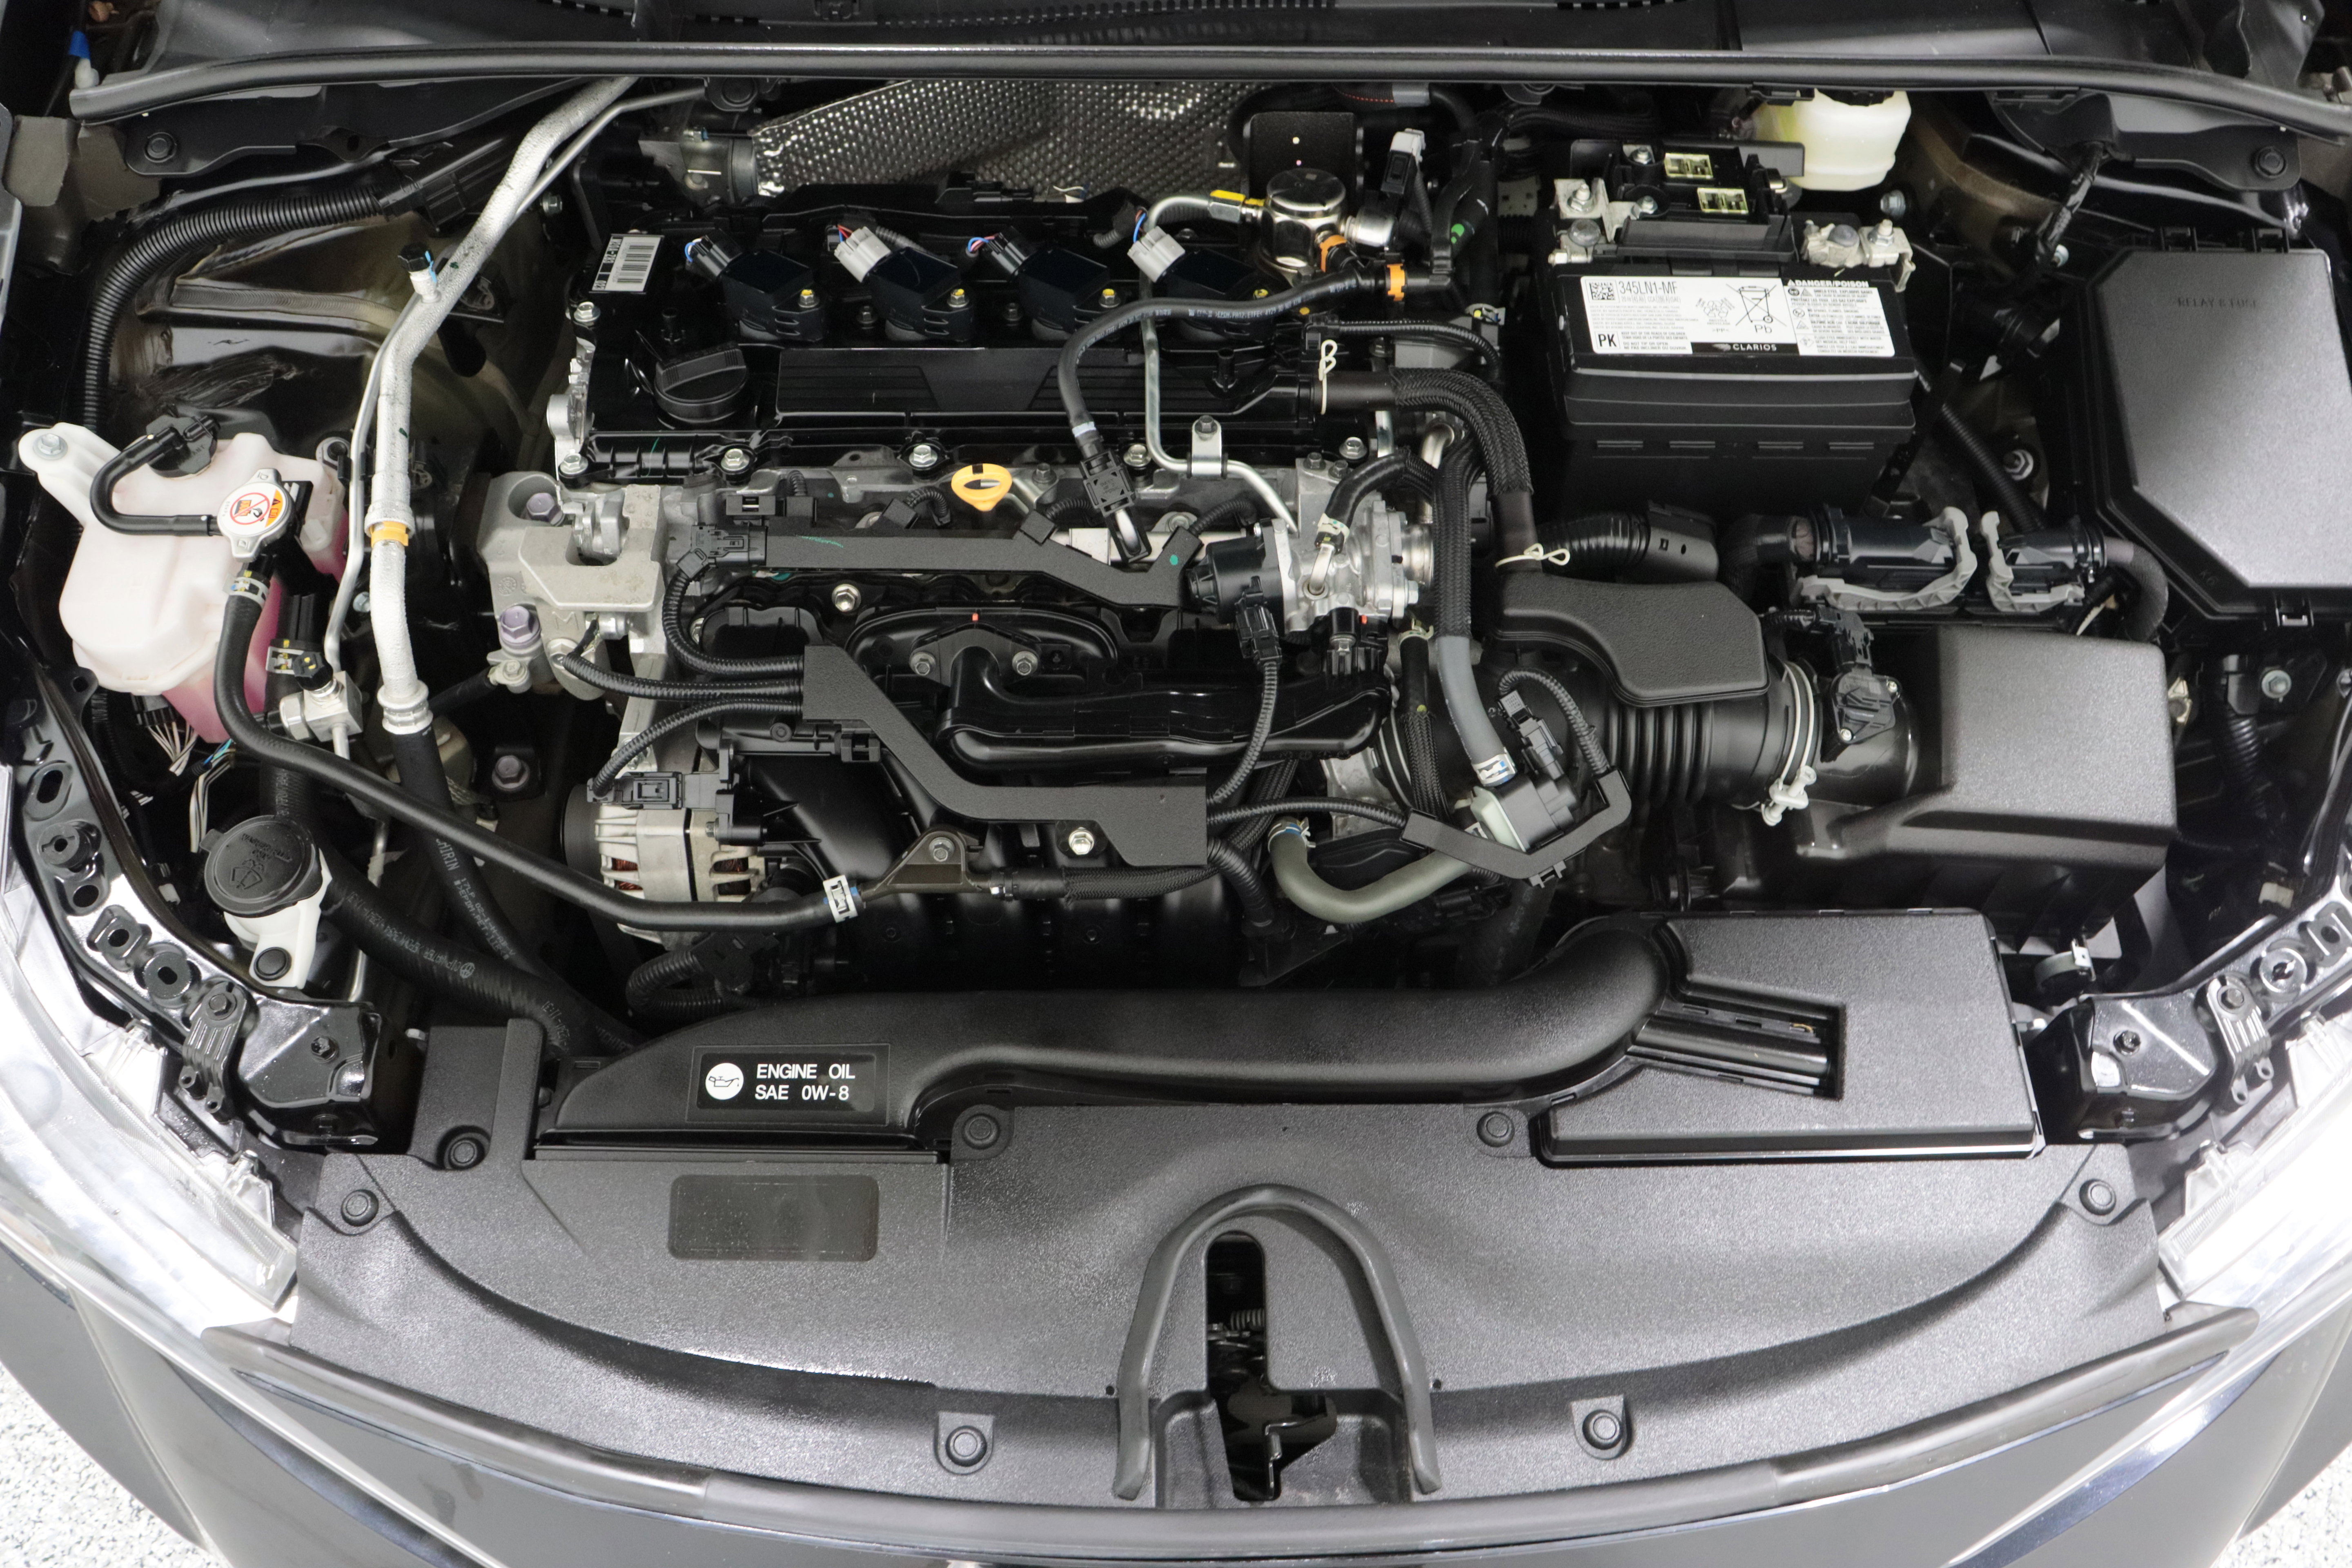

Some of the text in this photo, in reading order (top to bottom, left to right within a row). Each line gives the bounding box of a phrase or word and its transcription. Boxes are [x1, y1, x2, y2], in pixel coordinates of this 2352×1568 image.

[1619, 281, 1678, 294] 345LN1-MF
[1754, 325, 1772, 333] Pb
[1598, 334, 1617, 347] PK
[436, 838, 460, 871] HIRIN
[757, 1064, 855, 1079] ENGINE OIL
[755, 1085, 849, 1100] SAE 0W-8
